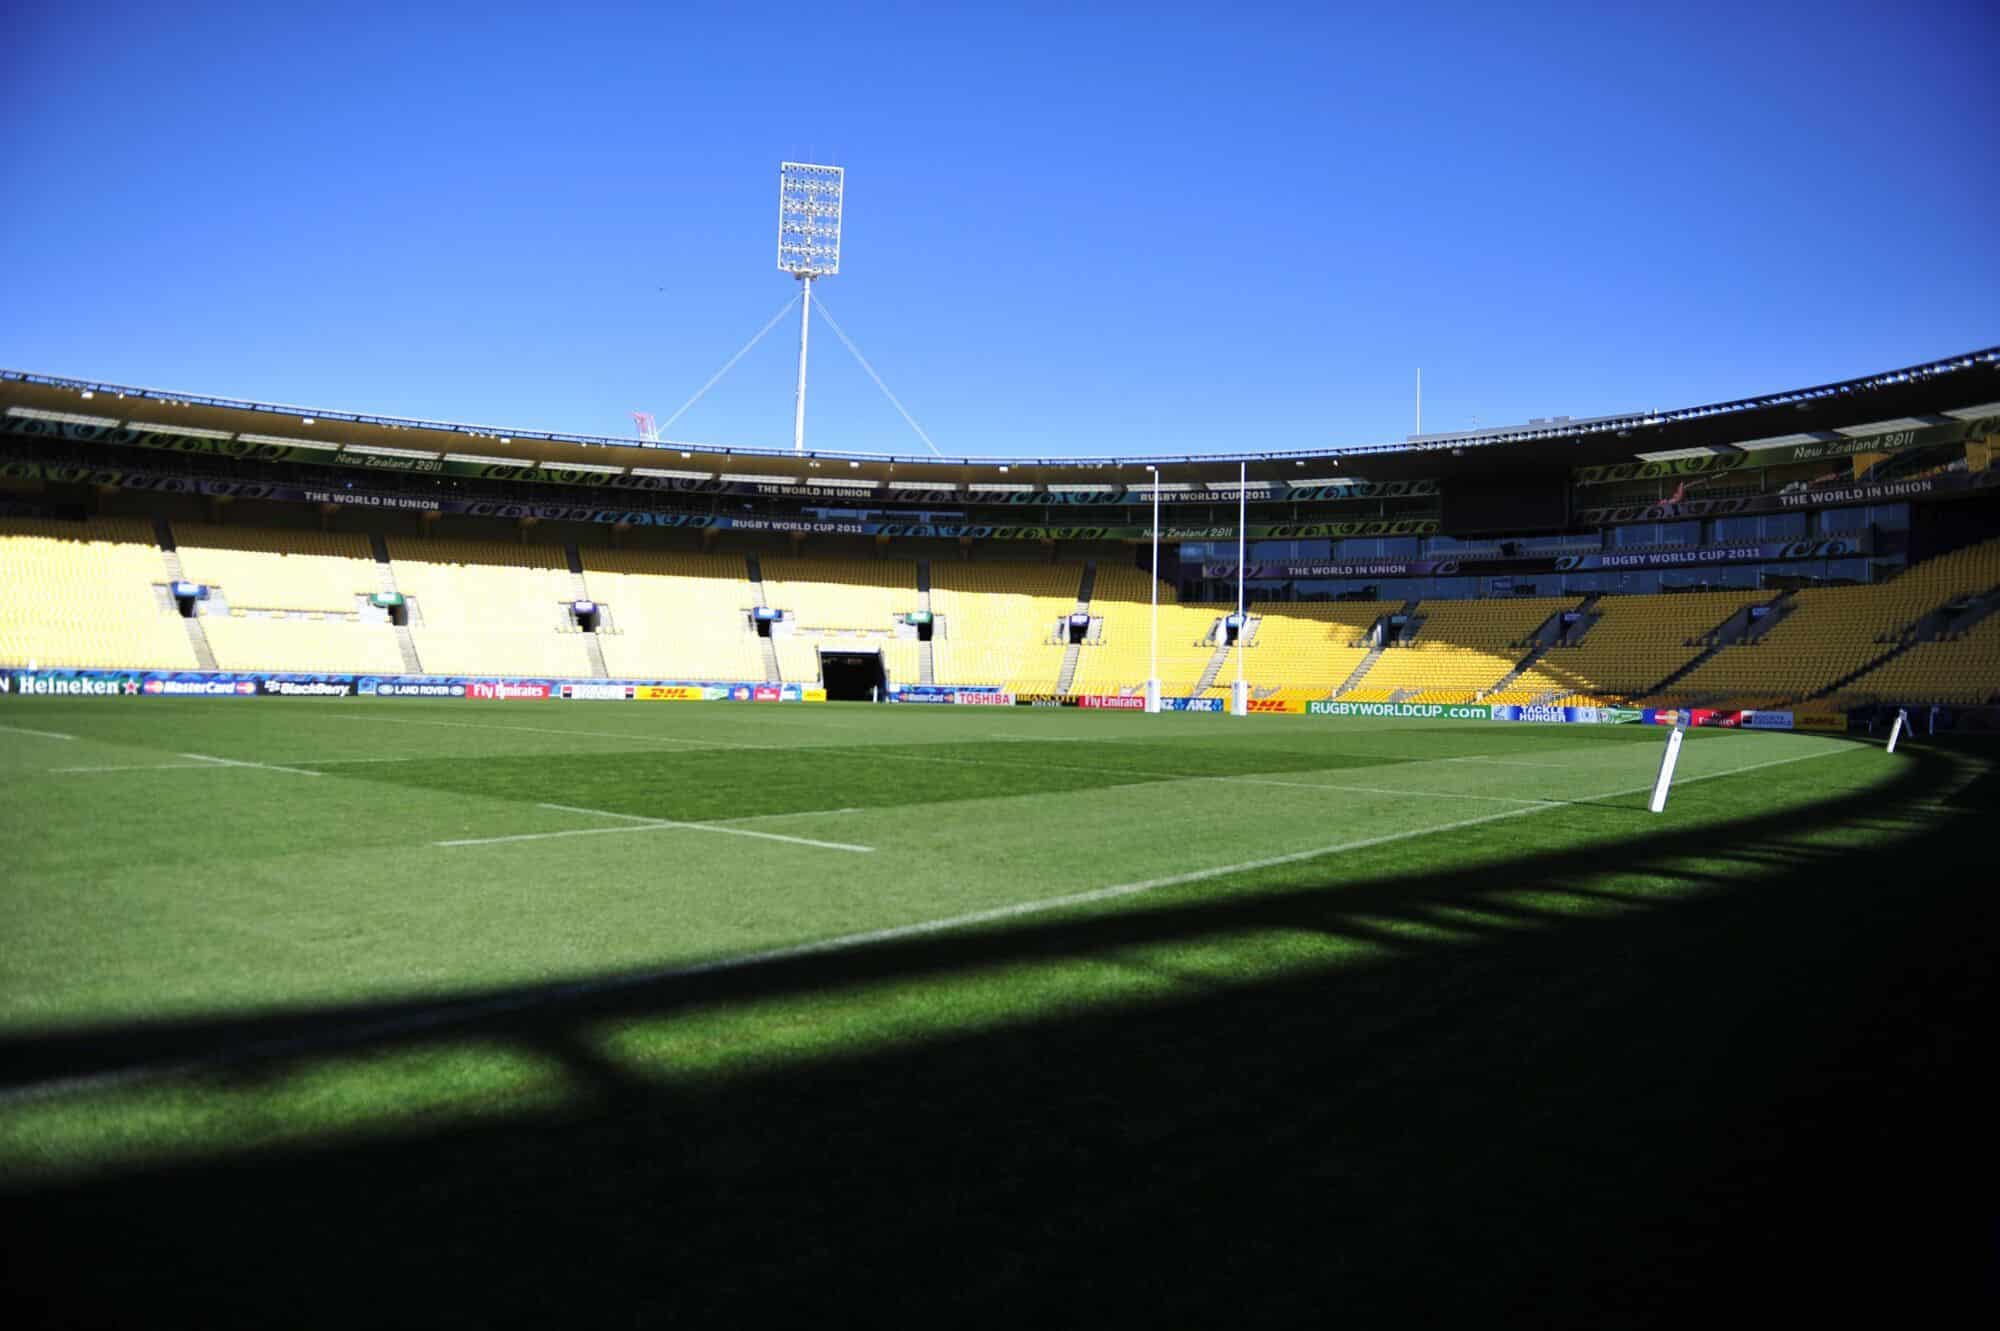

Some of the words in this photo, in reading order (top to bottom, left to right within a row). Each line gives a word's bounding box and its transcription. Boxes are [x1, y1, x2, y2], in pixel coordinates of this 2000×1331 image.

[1793, 446, 1823, 459] New
[1826, 439, 1881, 455] Zealand
[1884, 432, 1915, 449] 2011
[335, 454, 363, 465] New
[414, 460, 443, 472] 2011
[757, 484, 779, 494] THE
[781, 486, 821, 497] WORLD
[823, 488, 835, 498] IN
[836, 488, 872, 498] UNION
[1180, 491, 1219, 501] WORLD
[1246, 490, 1272, 500] 2011
[1780, 494, 1809, 506] THE
[1811, 488, 1863, 503] WORLD
[1867, 485, 1881, 497] IN
[1884, 480, 1933, 495] UNION
[303, 491, 331, 502] THE
[333, 494, 380, 506] WORLD
[383, 498, 397, 507] IN
[399, 498, 441, 511] UNION
[731, 519, 770, 530] RUGBY
[772, 521, 811, 532] WORLD
[813, 523, 836, 533] CUP
[837, 524, 863, 533] 2011
[1602, 555, 1645, 566] RUGBY
[1648, 553, 1697, 565] WORLD
[1699, 551, 1726, 562] CUP
[1728, 548, 1760, 560] 2011
[1288, 567, 1310, 576] THE
[1313, 566, 1352, 575] WORLD
[1355, 565, 1369, 575] IN
[1370, 564, 1406, 575] UNION
[19, 677, 119, 694] Heineken
[163, 680, 236, 693] MasterCard
[280, 682, 350, 697] BlackBerry
[395, 684, 419, 696] LAND
[420, 685, 449, 696] ROVER
[473, 684, 494, 698] Fly
[497, 684, 543, 698] Emirates
[650, 687, 689, 699] DHL
[959, 692, 1011, 705] TOSHIBA
[1085, 694, 1101, 706] Fly
[1102, 695, 1144, 708] Emirates
[1186, 699, 1214, 712] ANZ
[1247, 700, 1287, 712] DHL
[1311, 702, 1486, 718] RUGBYWORLDCUP.com
[1521, 704, 1566, 714] TACKLE
